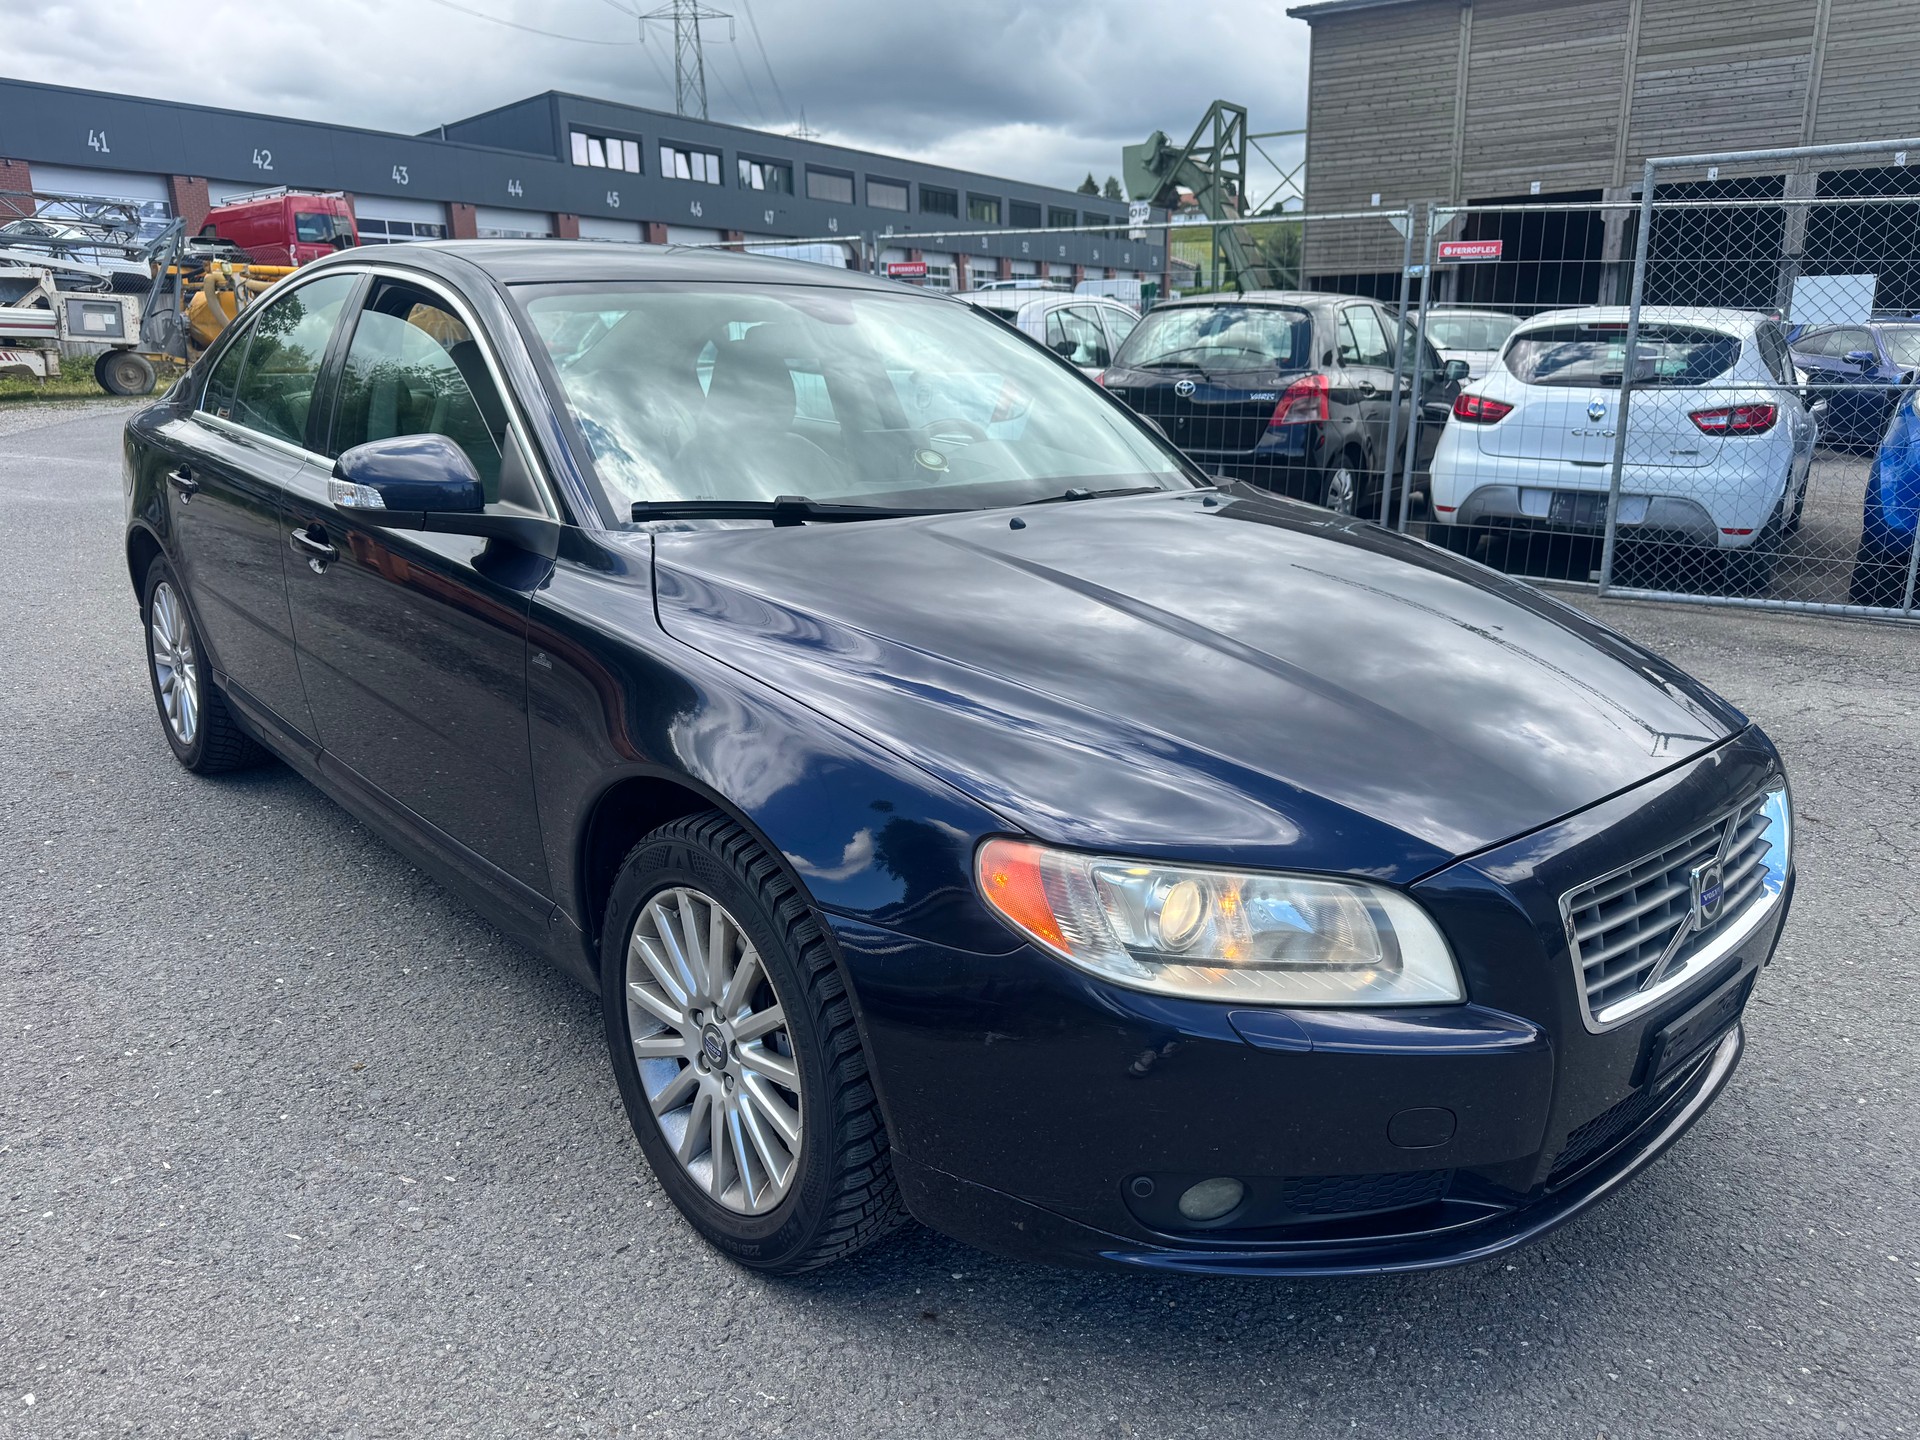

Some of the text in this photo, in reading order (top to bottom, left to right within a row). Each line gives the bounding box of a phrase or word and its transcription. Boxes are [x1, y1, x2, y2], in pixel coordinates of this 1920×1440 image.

[87, 130, 110, 153] 41
[252, 149, 273, 170] 42
[392, 165, 409, 185] 43
[508, 179, 523, 197] 44
[606, 191, 619, 207] 45
[690, 201, 702, 217] 46
[764, 210, 774, 225] 47
[1453, 246, 1497, 254] FERROFLEX
[1571, 428, 1615, 437] CLIO
